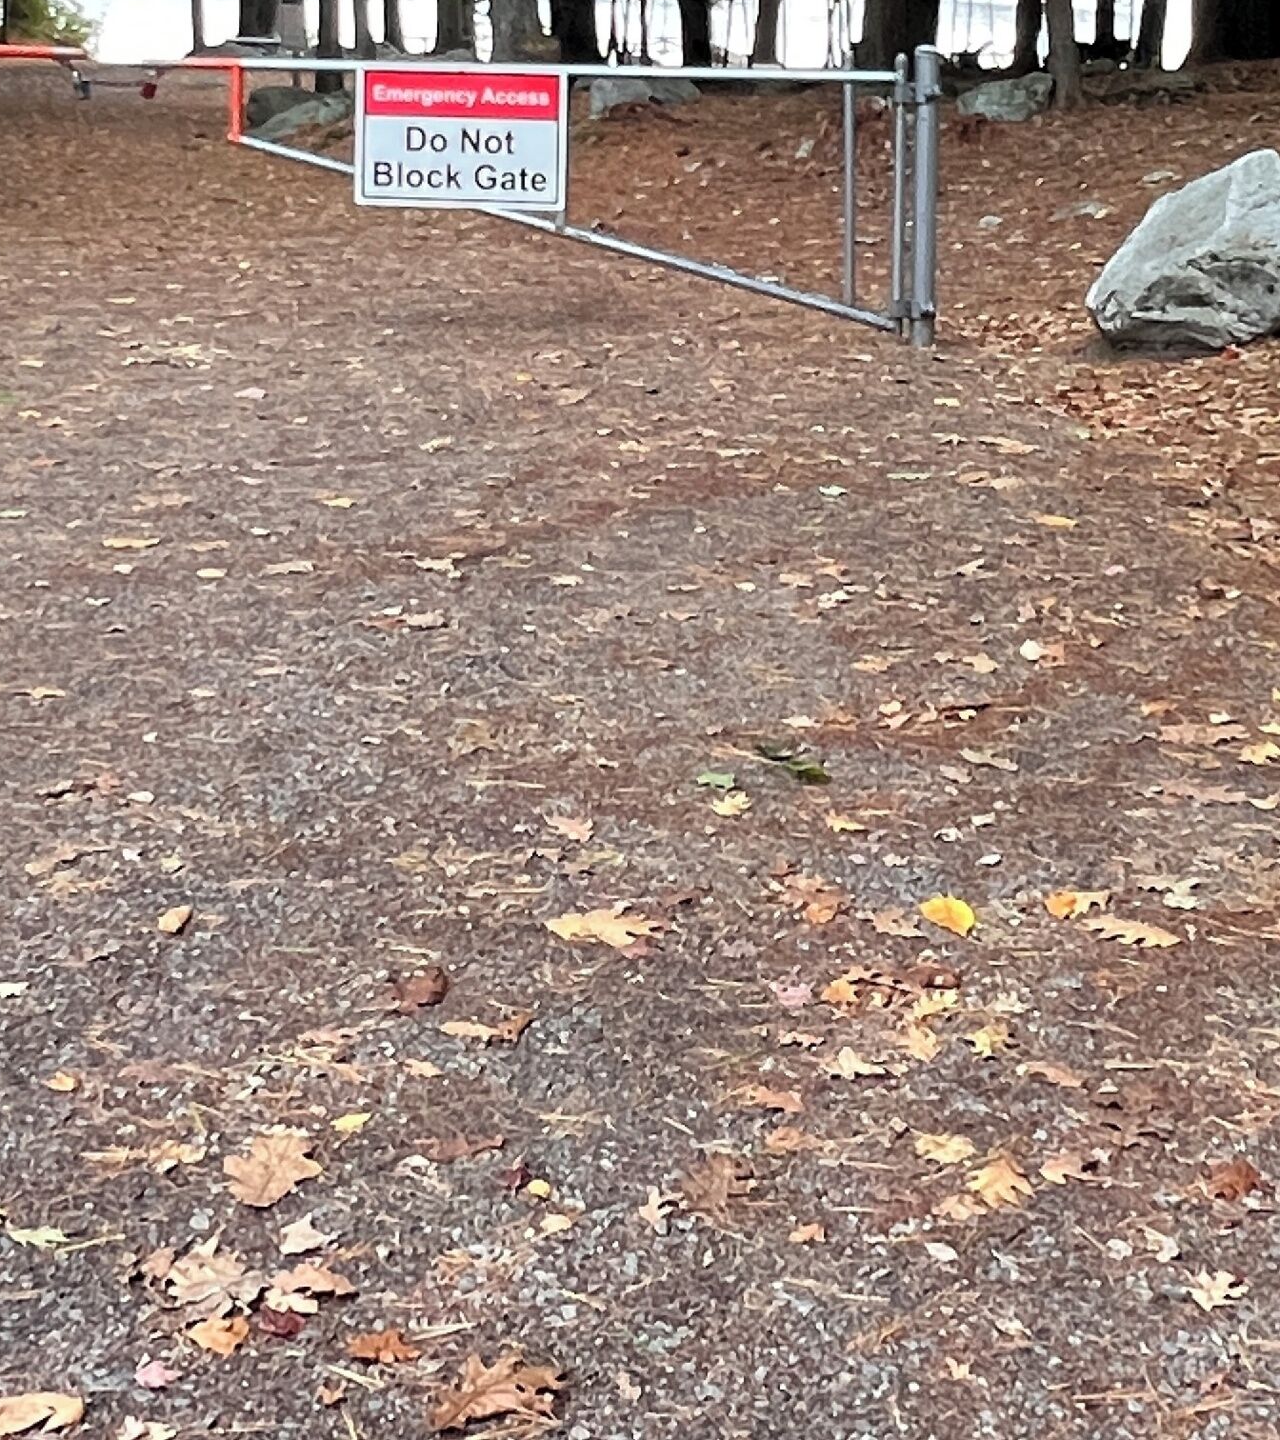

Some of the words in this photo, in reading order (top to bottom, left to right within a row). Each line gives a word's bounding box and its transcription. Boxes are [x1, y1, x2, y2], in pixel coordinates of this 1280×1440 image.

[373, 83, 477, 107] Emergency
[481, 86, 551, 106] Access
[406, 126, 447, 153] Do
[461, 128, 515, 154] Not
[373, 162, 462, 190] Block
[475, 165, 547, 191] Gate
